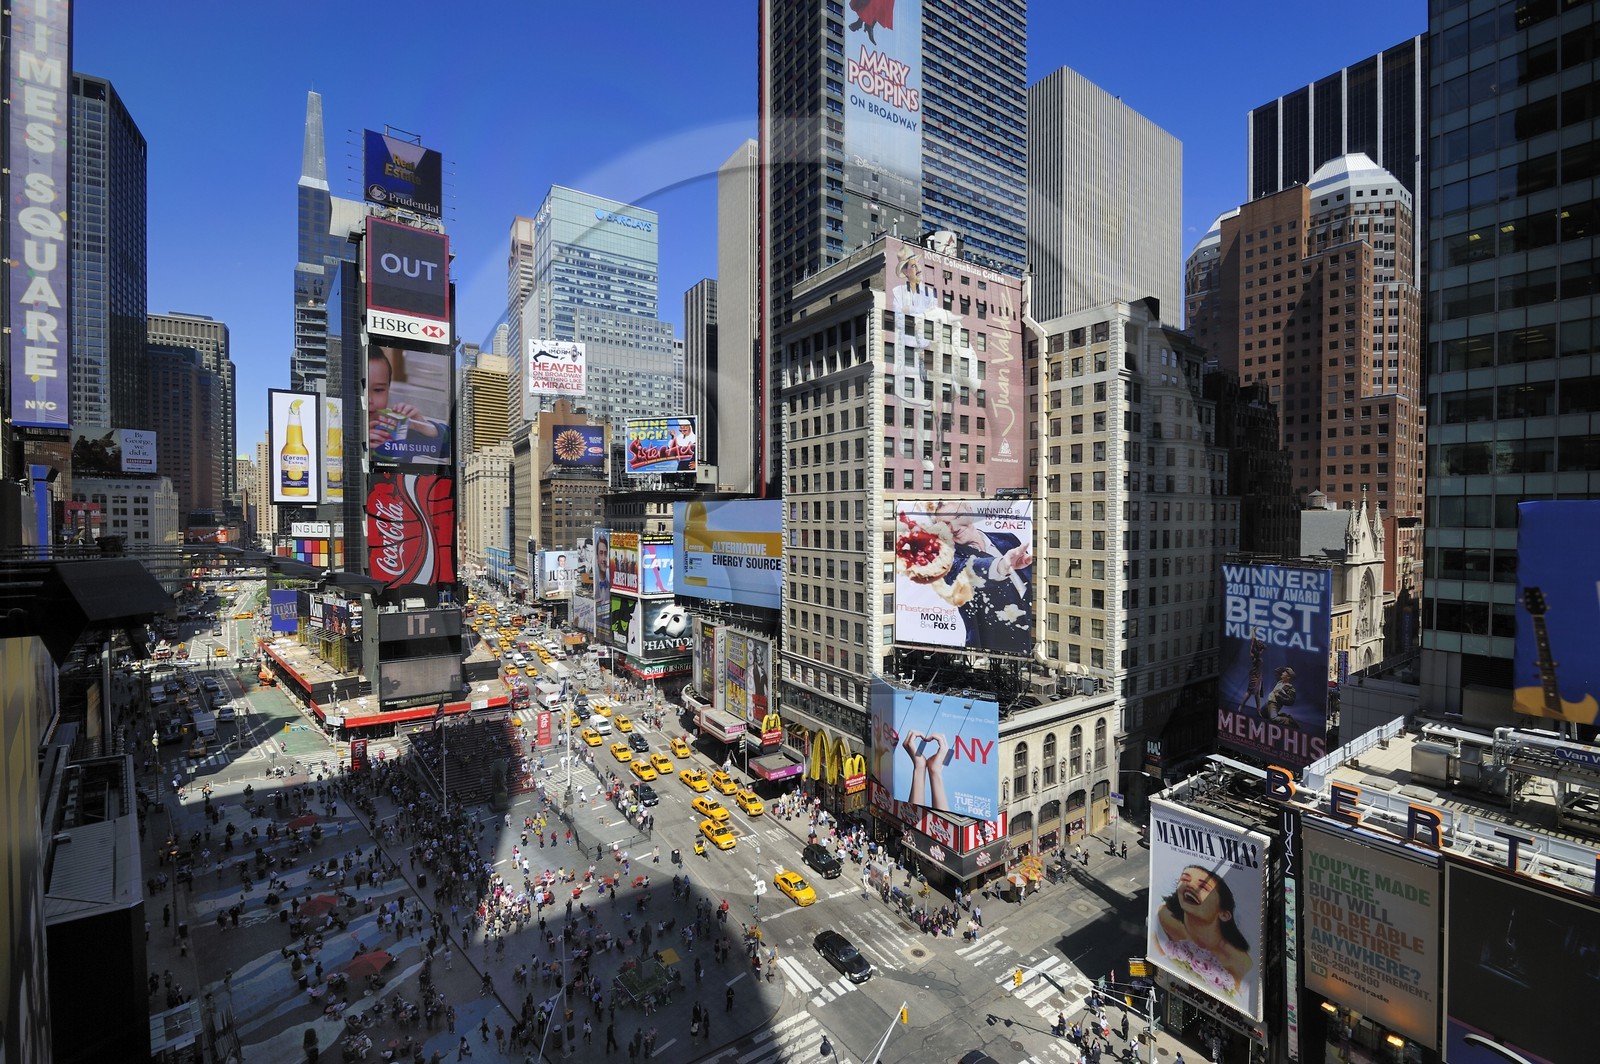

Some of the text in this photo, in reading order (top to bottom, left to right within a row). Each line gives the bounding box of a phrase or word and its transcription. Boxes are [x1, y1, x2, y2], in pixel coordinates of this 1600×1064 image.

[860, 45, 911, 86] MARY
[848, 58, 920, 112] POPPINS
[850, 94, 918, 132] ON BROADWAY
[392, 153, 416, 171] Real
[384, 162, 422, 185] Estate
[389, 192, 439, 214] Prudential
[606, 212, 653, 233] BARCLAYS
[18, 172, 65, 378] SQUARE
[380, 252, 438, 281] OUT
[944, 257, 982, 276] Colombian
[371, 316, 420, 335] HSBC
[532, 362, 582, 374] HEAVEN
[542, 382, 582, 390] MIRACLE
[24, 399, 57, 411] NYC
[629, 419, 668, 431] NUNS
[630, 430, 668, 441] ROCK!
[125, 437, 153, 445] George,
[384, 441, 437, 453] SAMSUNG
[628, 439, 667, 462] Sister
[292, 524, 331, 534] INGLOT
[994, 520, 1026, 530] CAKE!
[713, 541, 767, 556] ALTERNATIVE
[712, 554, 782, 571] ENERGY SOURCE
[1222, 565, 1326, 591] WINNER!
[1226, 583, 1321, 604] 2010 TONY AWARD
[407, 614, 436, 636] IT.
[920, 612, 943, 622] MON
[1225, 595, 1320, 634] BEST
[933, 621, 949, 630] FOX
[950, 623, 957, 631] 5
[1225, 621, 1320, 652] MUSICAL
[647, 665, 670, 674] sbarro
[1218, 709, 1325, 761] MEMPHIS
[955, 735, 995, 765] NY
[1147, 741, 1161, 756] HA!
[1563, 749, 1588, 762] Van
[955, 796, 974, 807] TUE
[968, 806, 984, 816] FOX
[1155, 820, 1216, 858] MAMMA
[1219, 835, 1259, 869] MIA!
[1309, 850, 1431, 908] YOU'VE MADE
[1309, 866, 1380, 905] IT HERE.
[1309, 880, 1394, 926] BUT WILL
[1310, 896, 1425, 955] YOU BE ABLE
[1310, 911, 1402, 962] TO RETIRE
[1311, 926, 1422, 987] ANYWHERE?
[1311, 951, 1380, 989] 800-290-0500
[1311, 942, 1432, 1002] ASK TEAM RETIREMENT.
[1313, 964, 1390, 1004] TD Ameritrade
